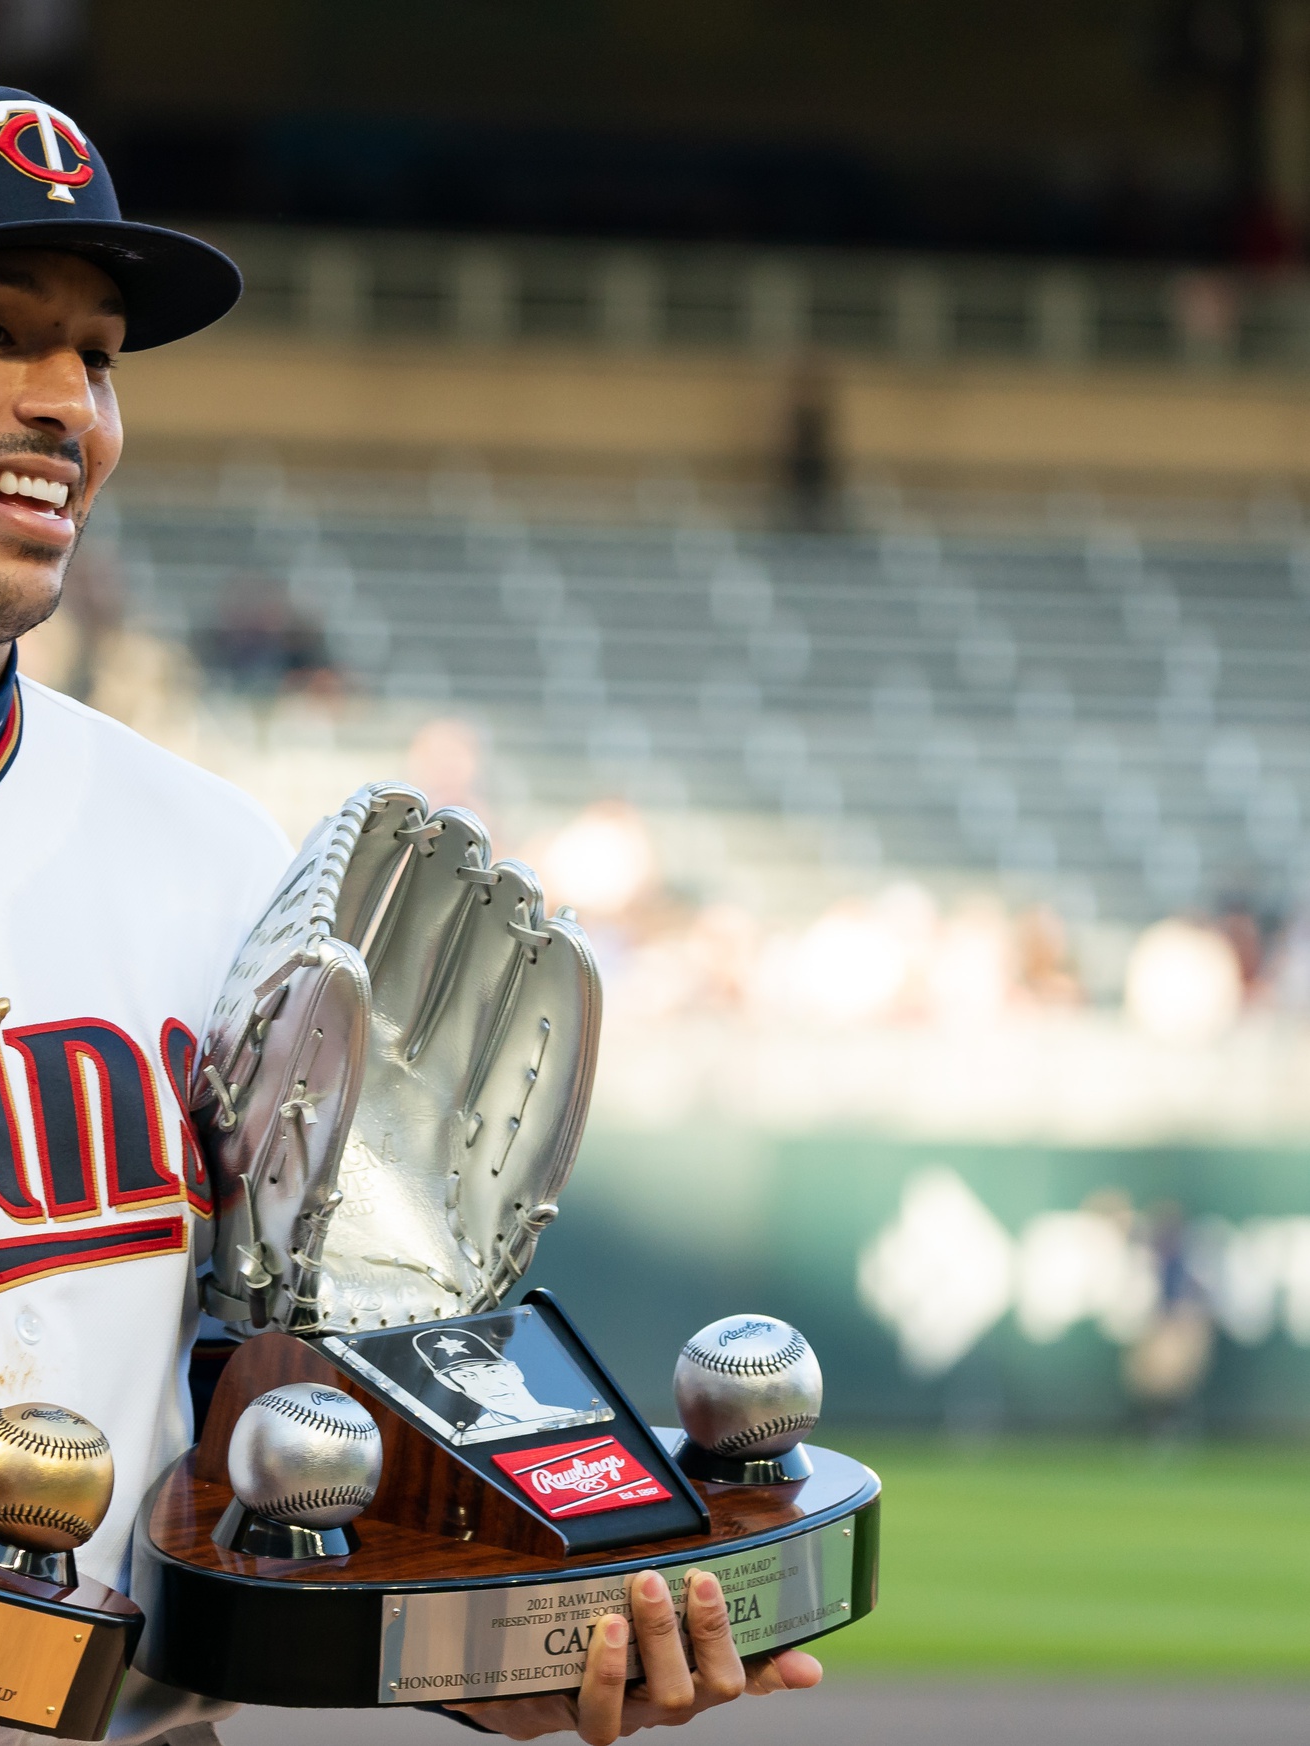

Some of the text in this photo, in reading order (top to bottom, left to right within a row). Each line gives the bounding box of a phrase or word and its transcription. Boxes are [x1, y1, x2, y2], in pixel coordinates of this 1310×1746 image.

[718, 1321, 777, 1347] Rawlings
[21, 1407, 89, 1426] Rawlings
[530, 1454, 626, 1495] Rawlings
[526, 1587, 627, 1612] 2021 RAWLINGS
[491, 1612, 553, 1629] PRESENTED
[554, 1610, 569, 1623] BY
[570, 1606, 591, 1621] THE
[739, 1628, 761, 1645] THE
[397, 1671, 481, 1690] HONORING
[484, 1670, 508, 1684] HIS
